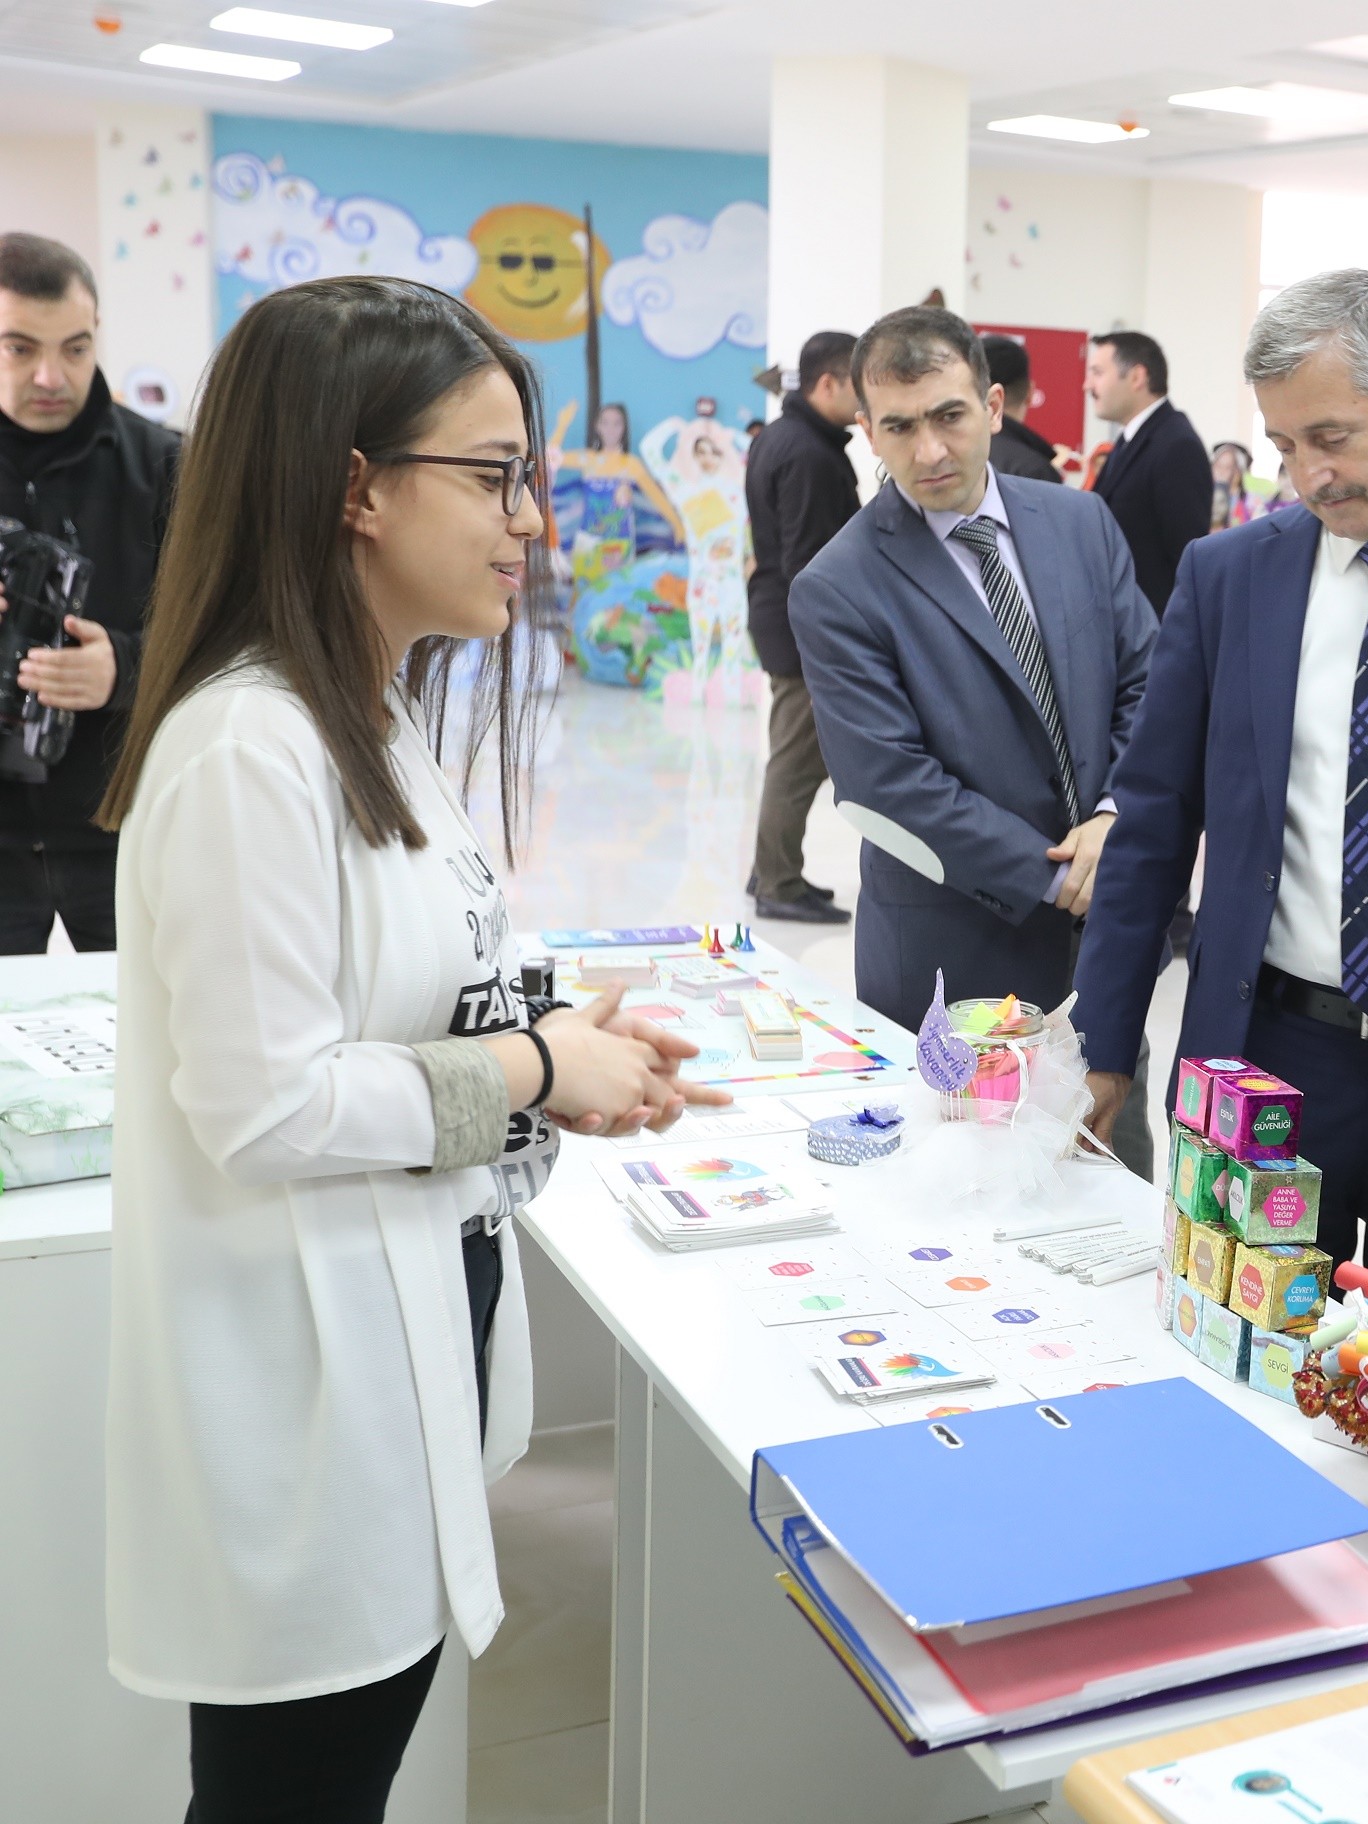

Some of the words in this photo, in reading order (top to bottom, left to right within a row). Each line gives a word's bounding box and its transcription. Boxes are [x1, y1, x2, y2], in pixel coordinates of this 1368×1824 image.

[1265, 1112, 1280, 1121] AİLE
[1253, 1120, 1291, 1131] GÜVENLİĞİ
[1273, 1210, 1294, 1218] DEĞER
[1240, 1275, 1263, 1296] KENDİNE
[1242, 1288, 1259, 1304] SAYGI
[1287, 1295, 1313, 1303] KORUMA
[1267, 1358, 1289, 1374] SEVGİ
